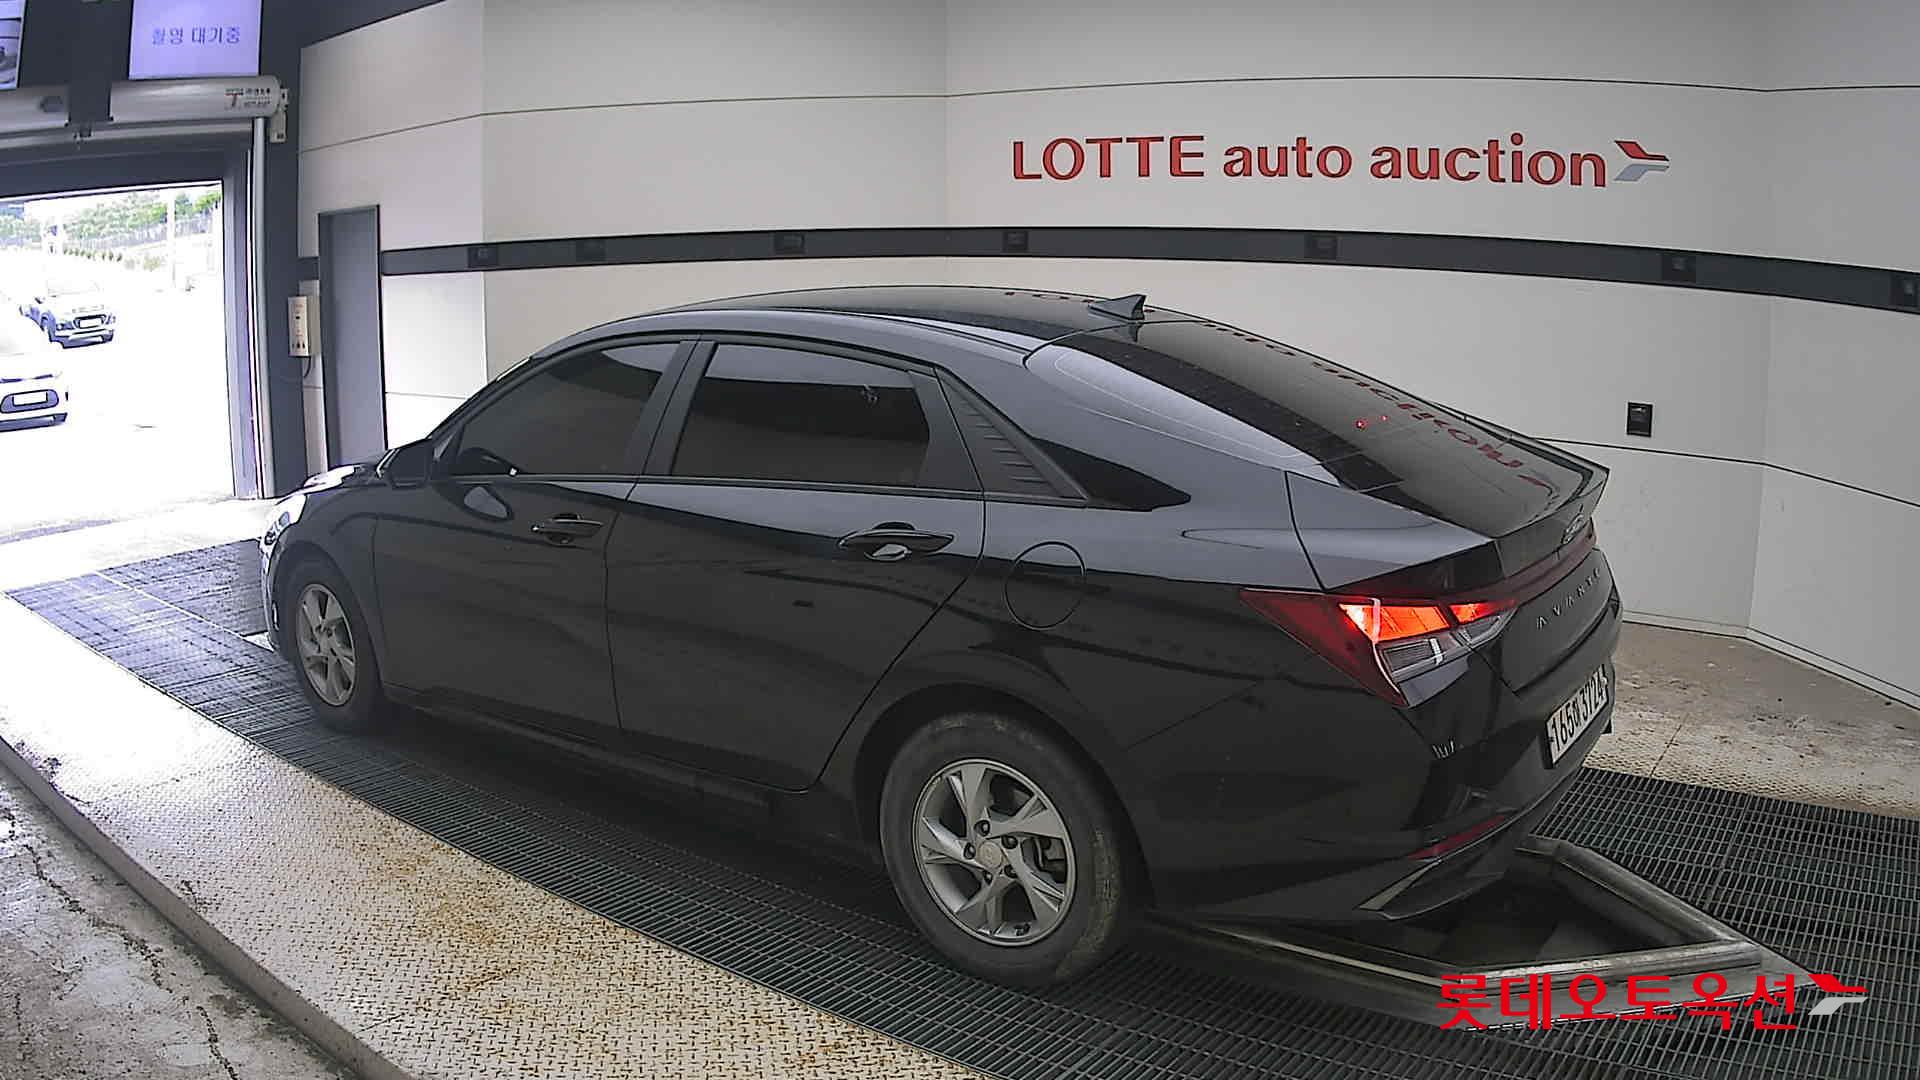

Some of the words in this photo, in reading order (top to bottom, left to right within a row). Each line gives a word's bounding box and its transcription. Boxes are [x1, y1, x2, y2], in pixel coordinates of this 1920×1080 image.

[191, 25, 241, 45] 대기중
[1012, 135, 1205, 181] LOTTE
[1223, 136, 1352, 178] auto
[1369, 132, 1607, 187] auction
